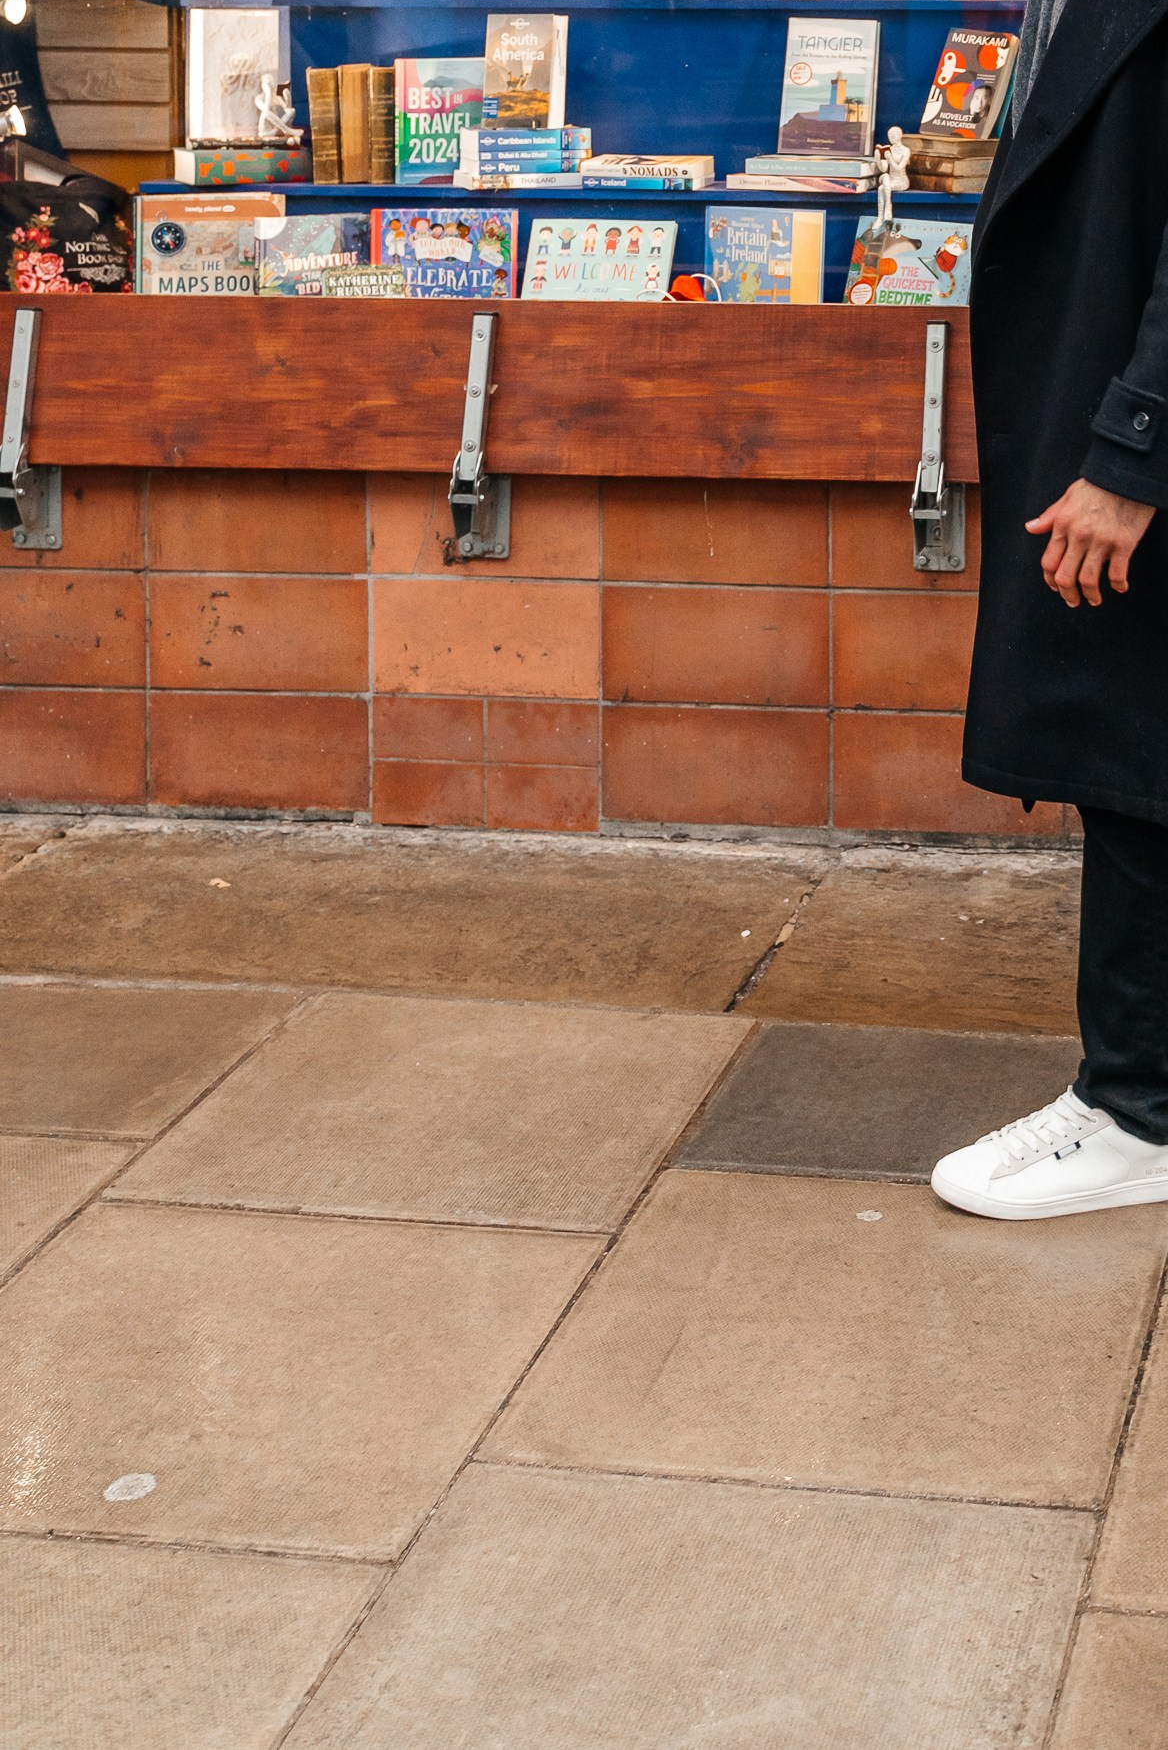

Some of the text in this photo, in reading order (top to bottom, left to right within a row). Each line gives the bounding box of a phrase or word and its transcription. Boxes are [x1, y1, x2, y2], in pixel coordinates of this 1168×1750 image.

[501, 32, 538, 45] South
[798, 35, 863, 52] TANGIER
[952, 32, 1008, 47] MURAKAMI
[492, 48, 544, 61] America
[408, 87, 463, 109] BEST IN
[940, 111, 973, 122] NOVELIST
[407, 112, 470, 135] TRAVEL
[932, 118, 941, 126] AS
[946, 121, 976, 130] VOCATION
[498, 137, 556, 145] Caribbean Islands
[409, 138, 459, 164] 2024
[498, 163, 520, 172] Peru
[629, 166, 678, 177] NOMADS
[728, 227, 767, 247] Britain
[731, 245, 767, 264] Ireland
[202, 260, 221, 270] THE
[901, 266, 919, 277] THE
[159, 275, 251, 294] MAPS BOO
[329, 275, 400, 287] KATHERINE
[406, 267, 492, 291] ELEBRATE
[883, 277, 934, 291] QUICKEST
[337, 285, 392, 297] RUNDELL
[878, 290, 932, 305] BEDTIME
